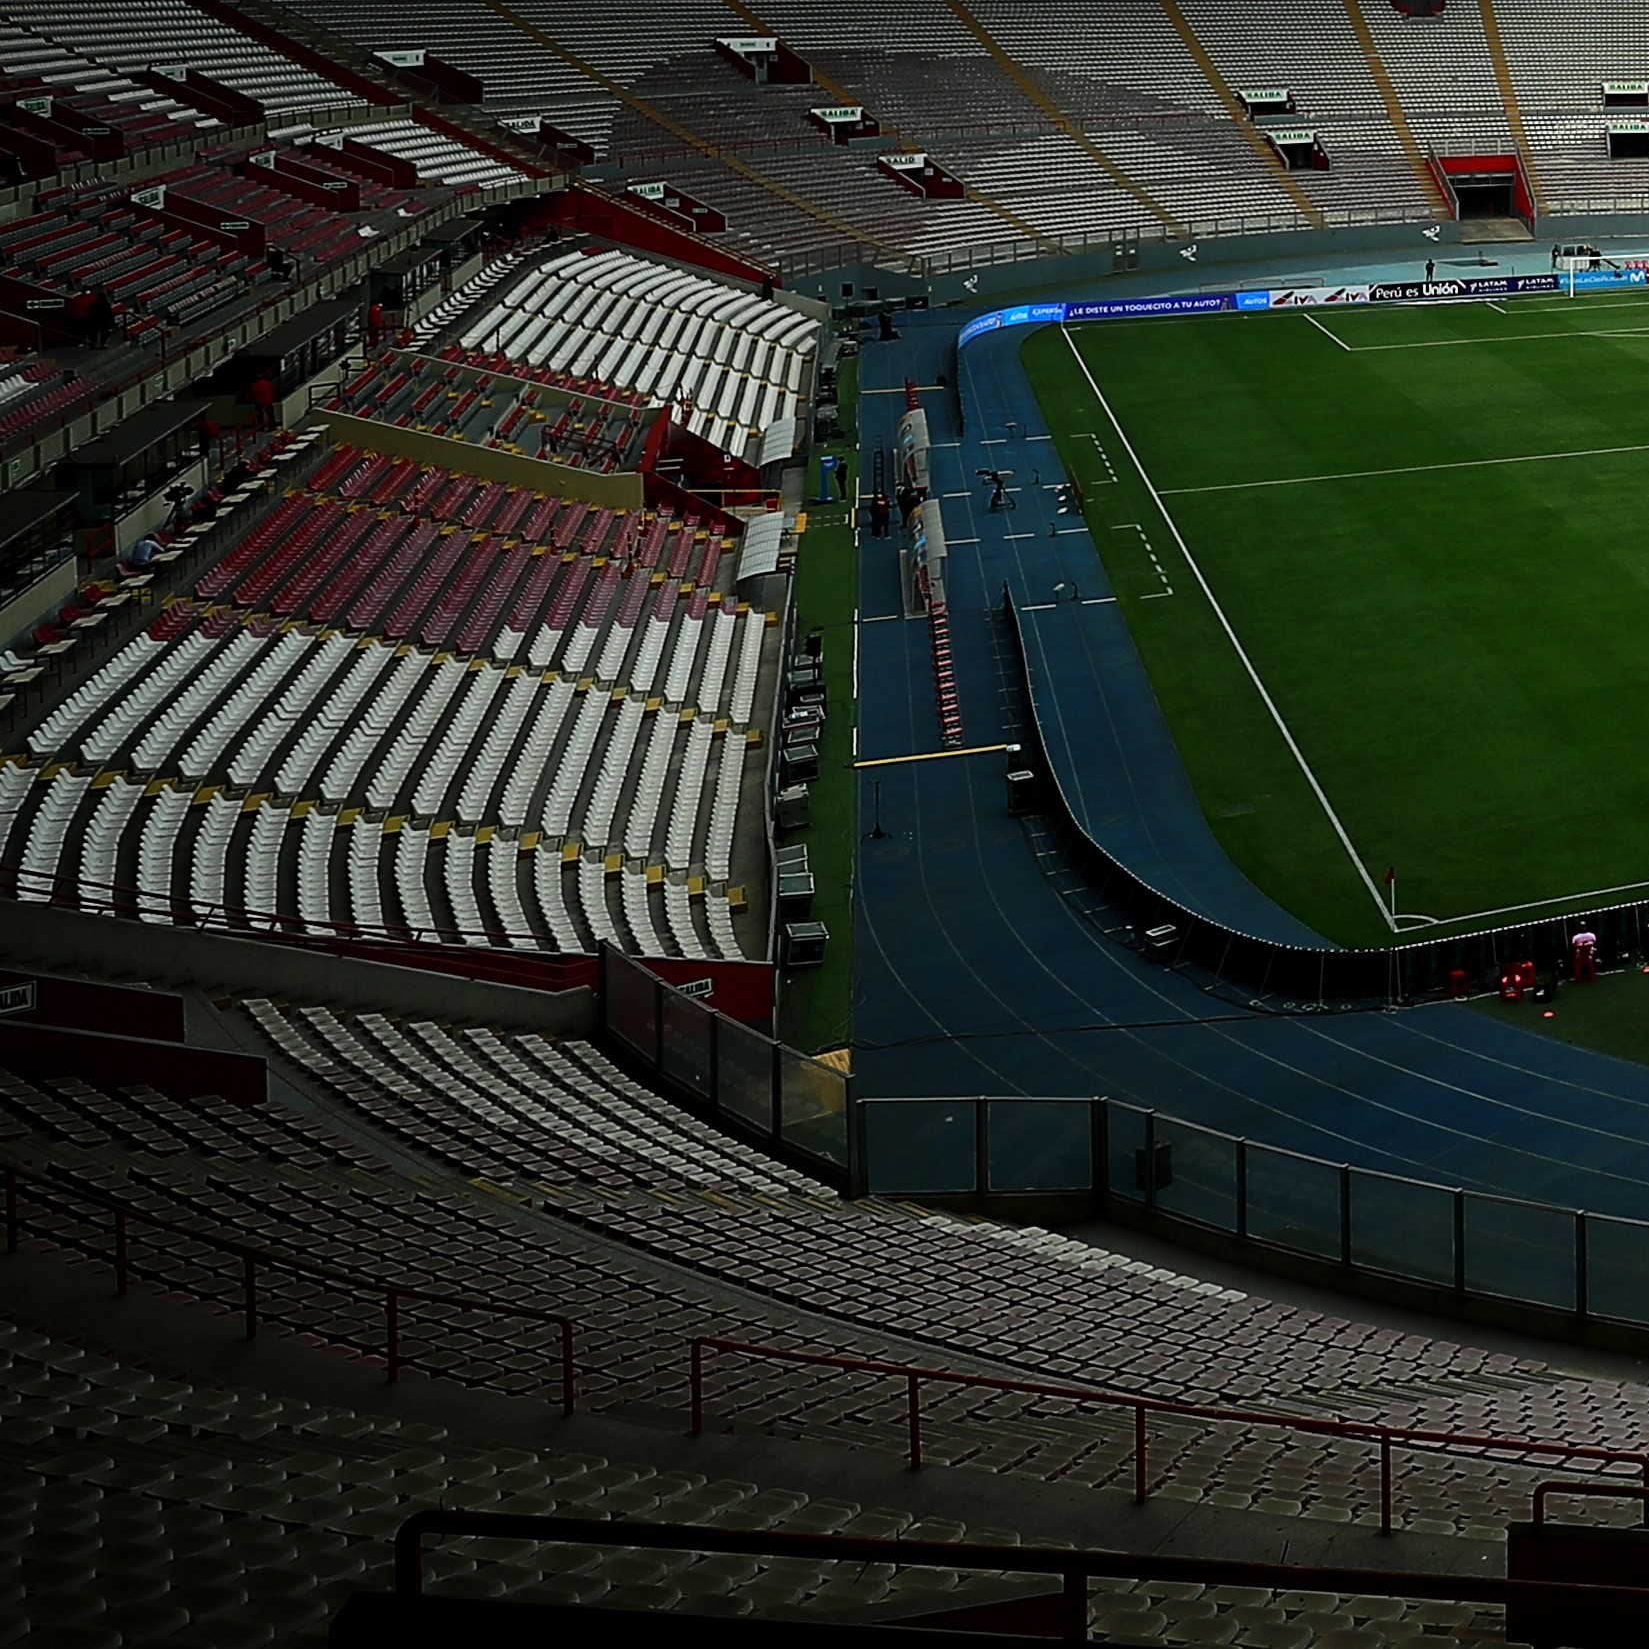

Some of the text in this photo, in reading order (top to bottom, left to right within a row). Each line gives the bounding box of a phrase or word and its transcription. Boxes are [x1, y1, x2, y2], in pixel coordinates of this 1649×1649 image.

[1376, 283, 1458, 299] Perú es Unión
[1085, 306, 1109, 314] DISTE
[1110, 305, 1124, 313] UN
[1126, 302, 1172, 313] TOQUECITO
[1193, 299, 1220, 308] AUTO?
